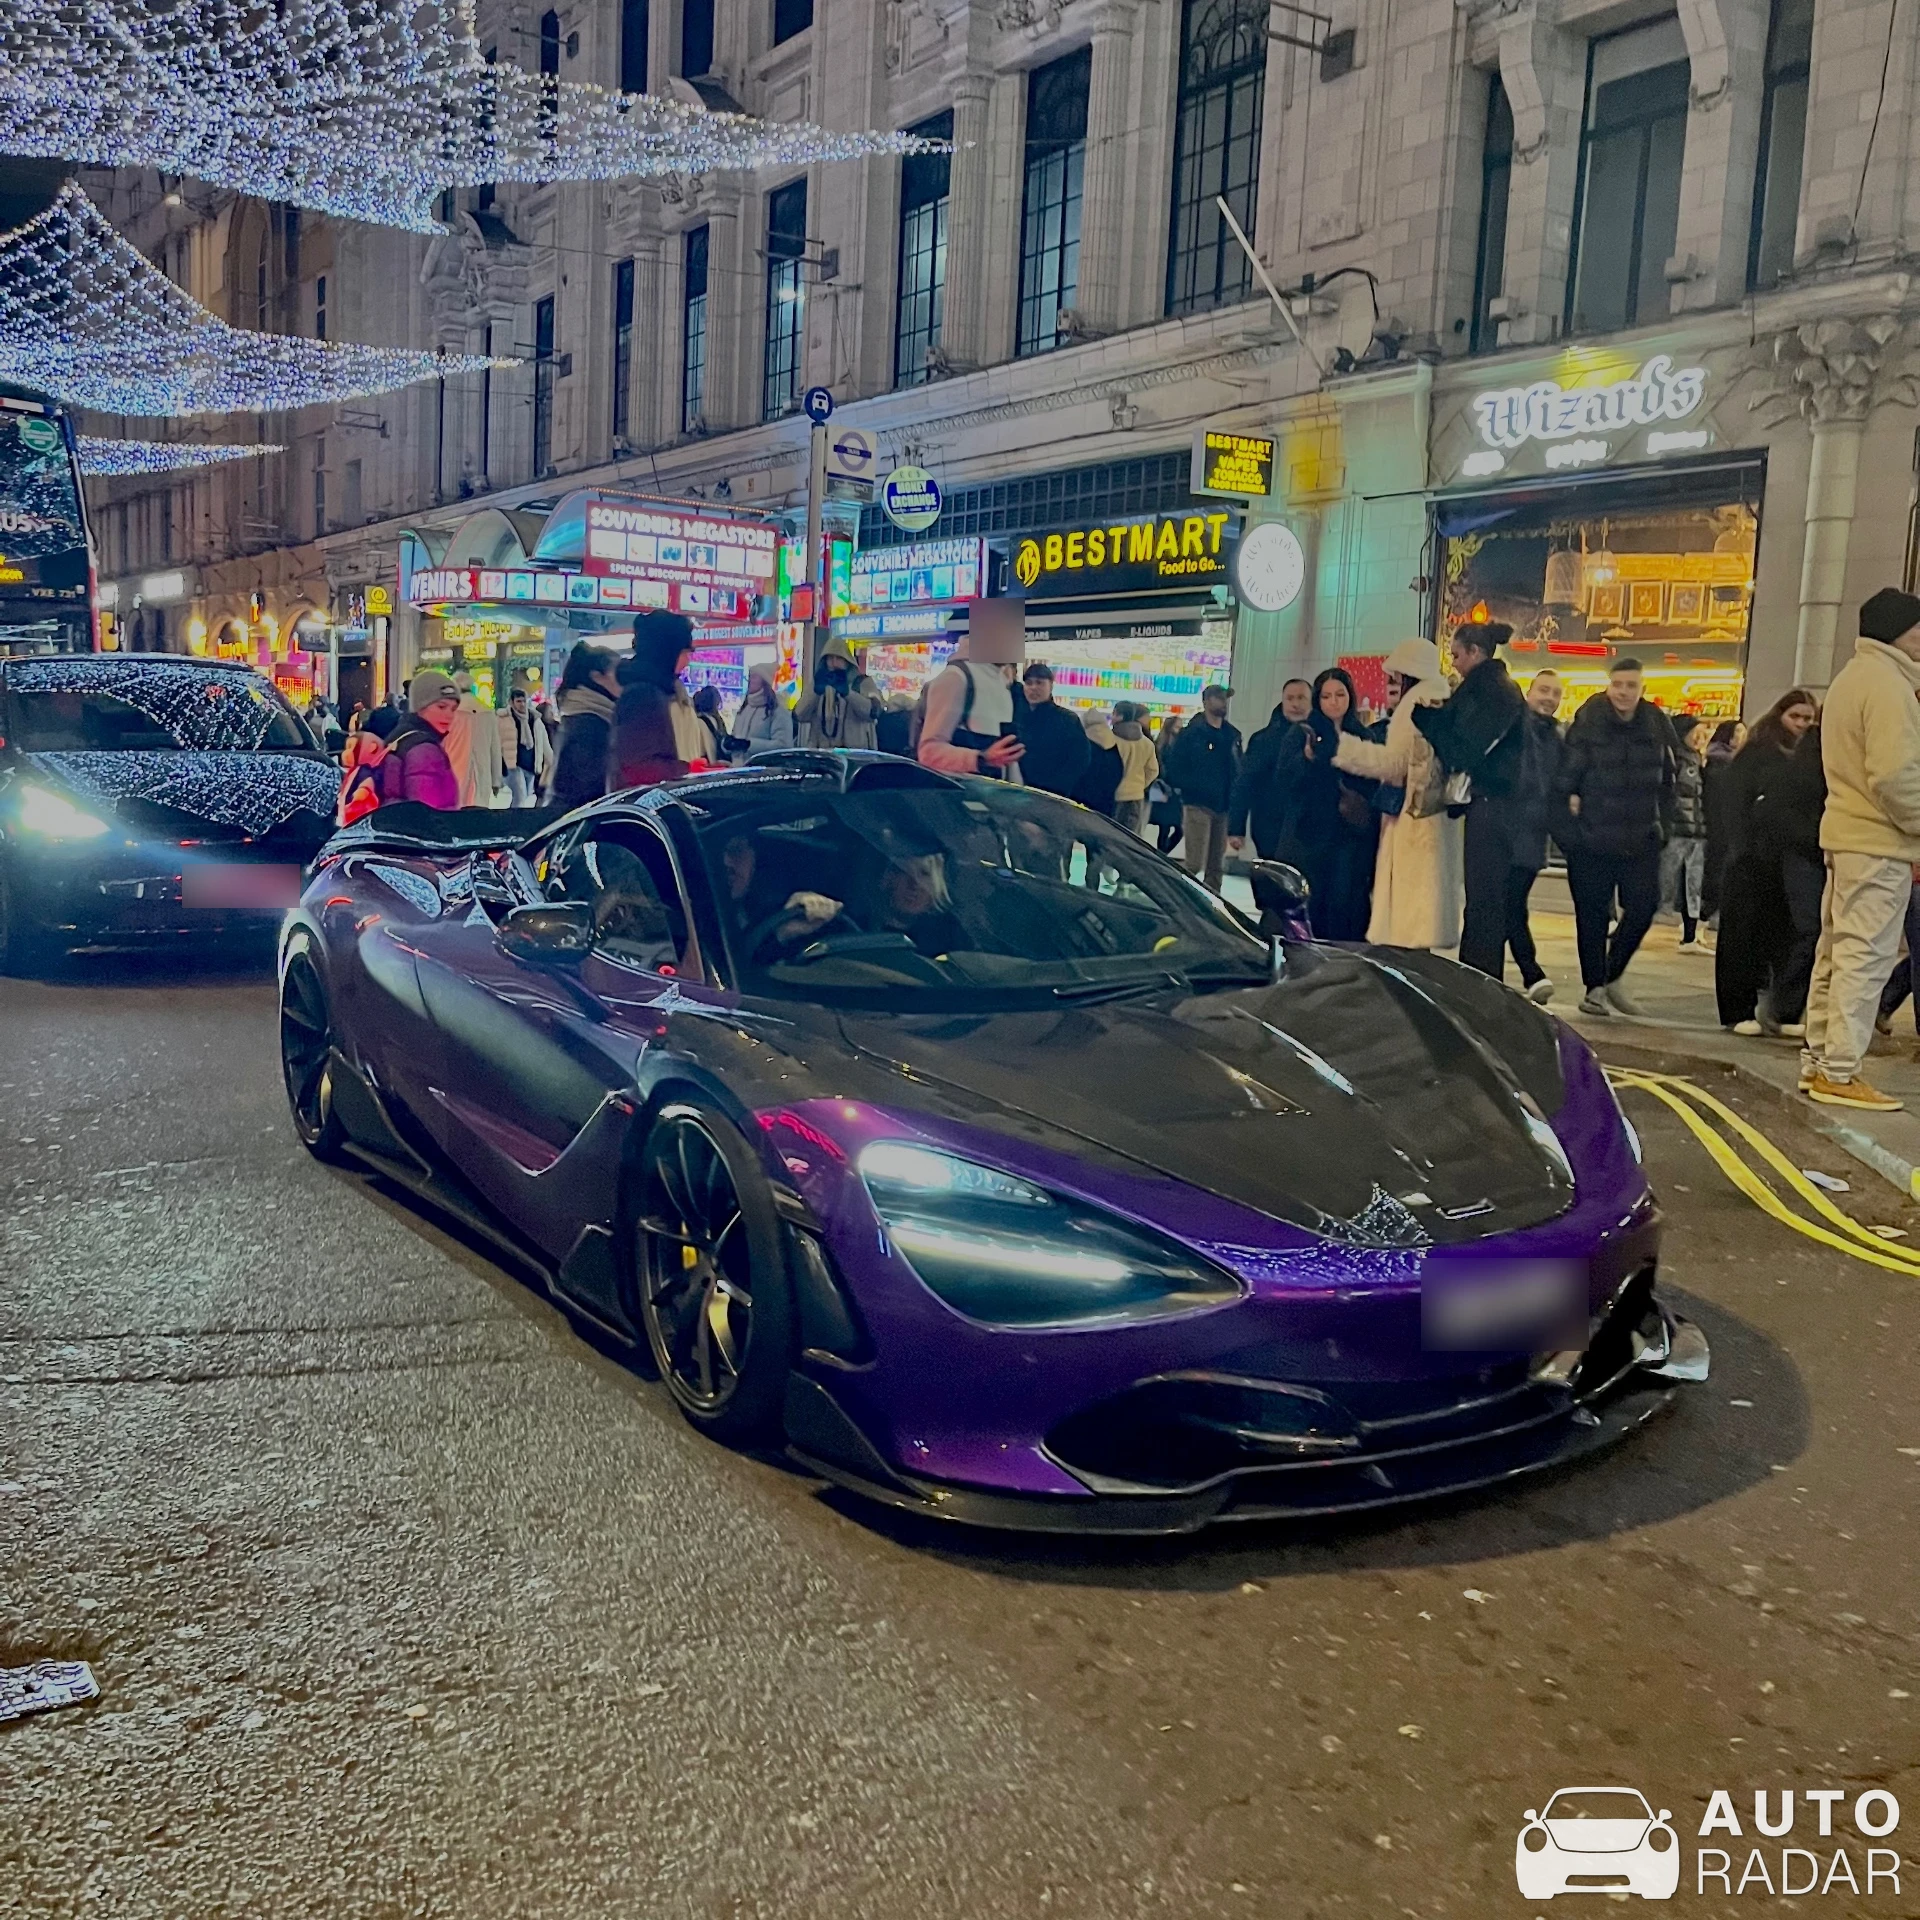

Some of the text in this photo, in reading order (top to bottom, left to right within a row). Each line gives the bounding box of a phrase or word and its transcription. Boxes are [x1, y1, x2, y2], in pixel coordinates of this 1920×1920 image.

[1476, 357, 1703, 445] Wizards
[1206, 433, 1272, 454] BESTMART
[1218, 455, 1259, 473] VAPES
[1213, 468, 1263, 485] TOBACCO
[896, 480, 927, 494] MONEY
[890, 493, 937, 508] EXCHANGE
[590, 506, 776, 549] SOUVENIRS MEGASTORE
[1045, 512, 1229, 571] BESTMART
[851, 552, 908, 574] SOUVENIRS
[909, 543, 979, 568] MEGASTORE
[1159, 559, 1185, 576] Food
[1186, 558, 1198, 573] to
[609, 562, 646, 577] SPECIAL
[648, 567, 691, 582] DISCOUNT
[847, 613, 937, 635] MONEY EXCHANGE
[1075, 628, 1102, 639] VAPES
[1130, 625, 1172, 638] E-LIQUIDS
